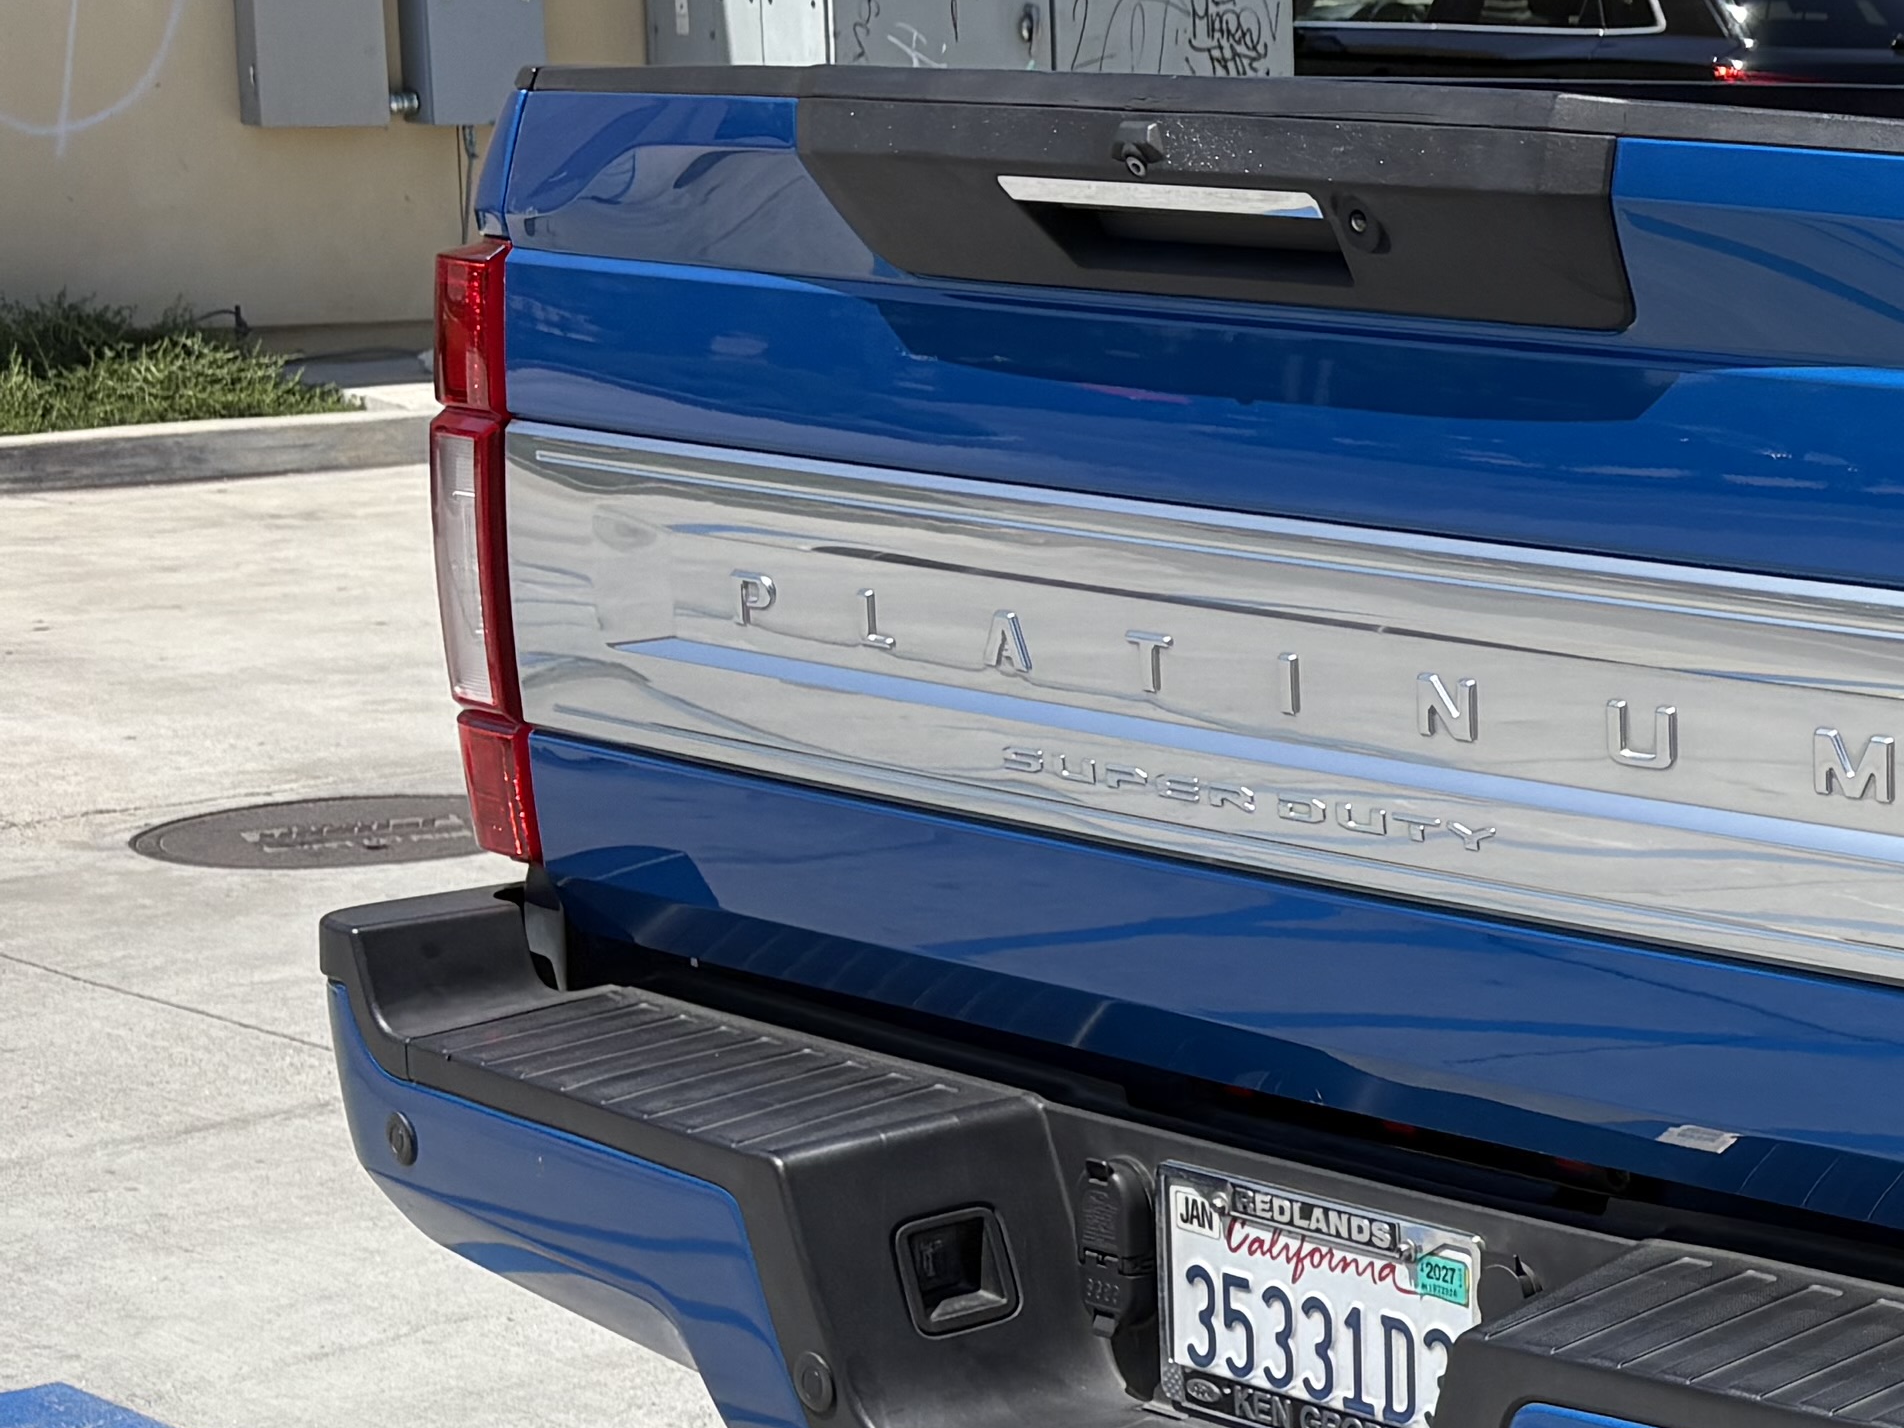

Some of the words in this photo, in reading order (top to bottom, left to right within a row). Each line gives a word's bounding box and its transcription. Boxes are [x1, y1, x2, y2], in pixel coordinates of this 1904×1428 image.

[730, 569, 1897, 804] PLATINUM
[1002, 746, 1256, 813] SUPER
[1277, 791, 1497, 852] DUTY
[1180, 1196, 1213, 1232] JAN
[1234, 1187, 1394, 1250] REDLANDS
[1225, 1219, 1424, 1296] California
[1426, 1262, 1456, 1285] 2027
